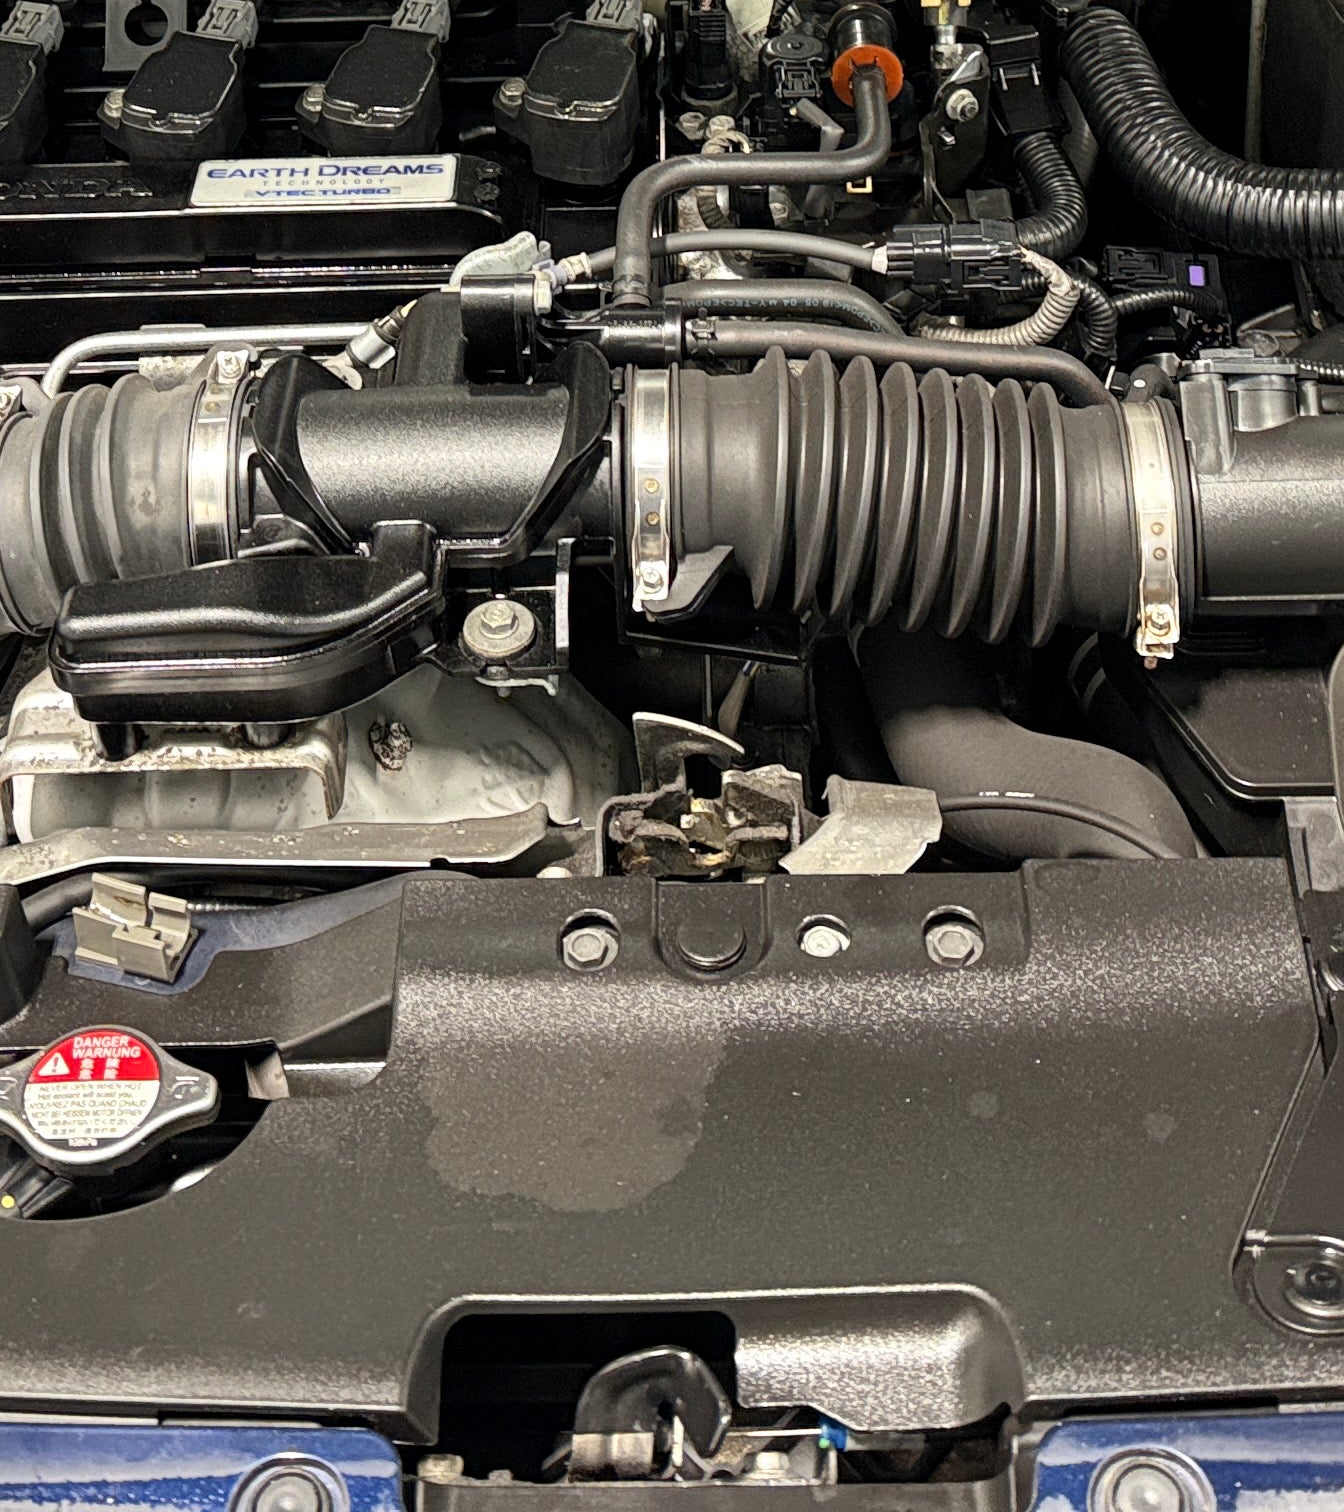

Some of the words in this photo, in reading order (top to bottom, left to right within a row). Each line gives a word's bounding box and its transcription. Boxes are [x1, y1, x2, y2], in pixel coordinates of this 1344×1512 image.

[207, 167, 309, 179] EARTH
[318, 163, 444, 177] DREAMS
[262, 178, 385, 187] TECHNOLOGY
[73, 1035, 129, 1048] DANGER
[72, 1046, 141, 1059] WARNUNG
[124, 1082, 142, 1090] HOT
